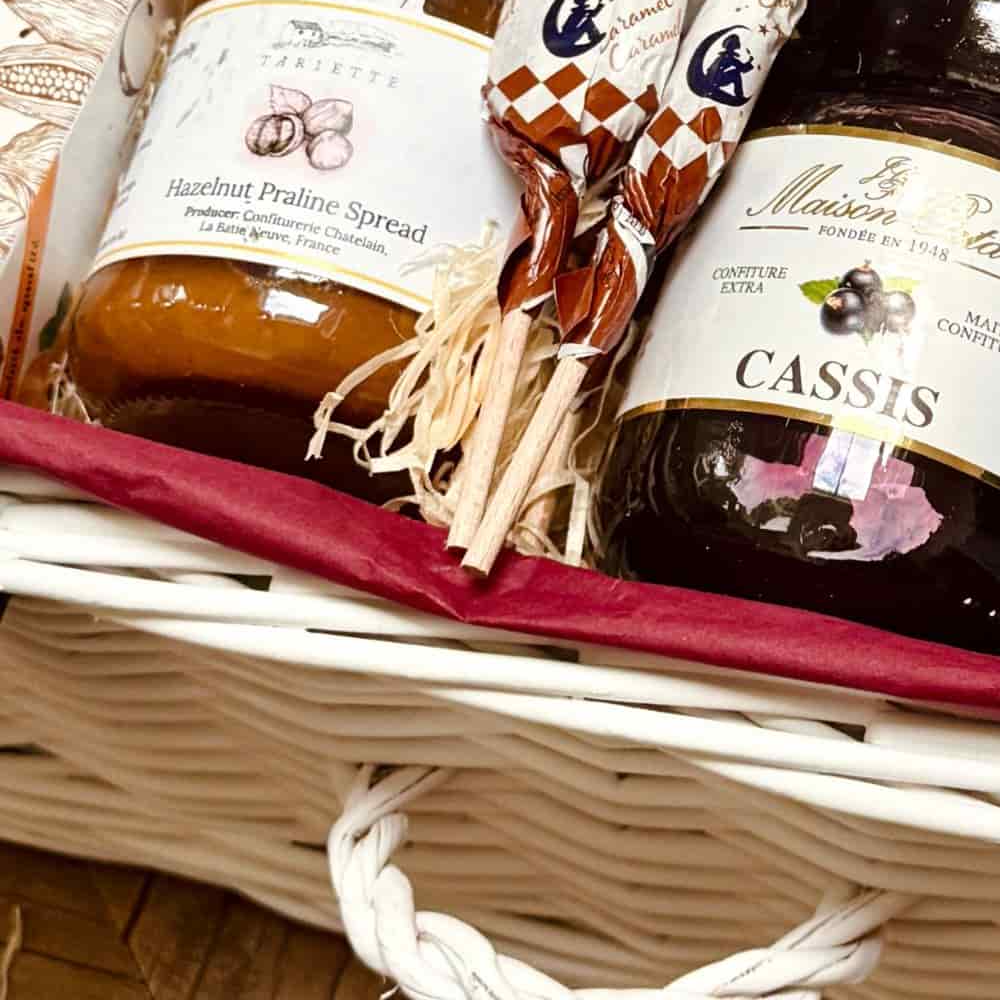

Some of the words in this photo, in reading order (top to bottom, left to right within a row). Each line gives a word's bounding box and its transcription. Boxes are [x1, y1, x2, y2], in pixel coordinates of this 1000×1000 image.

[260, 54, 402, 89] TARIETTE
[165, 176, 253, 200] Hazelnut
[257, 182, 341, 216] Praline
[344, 200, 428, 245] Spread
[745, 163, 898, 226] Maison
[199, 220, 214, 232] La
[296, 233, 341, 256] France
[243, 209, 322, 235] Confiturerie
[880, 234, 903, 249] EN
[909, 239, 951, 264] 1948
[712, 265, 789, 281] CONFITURE
[719, 281, 764, 294] EXTRA
[735, 348, 941, 429] CASSIS
